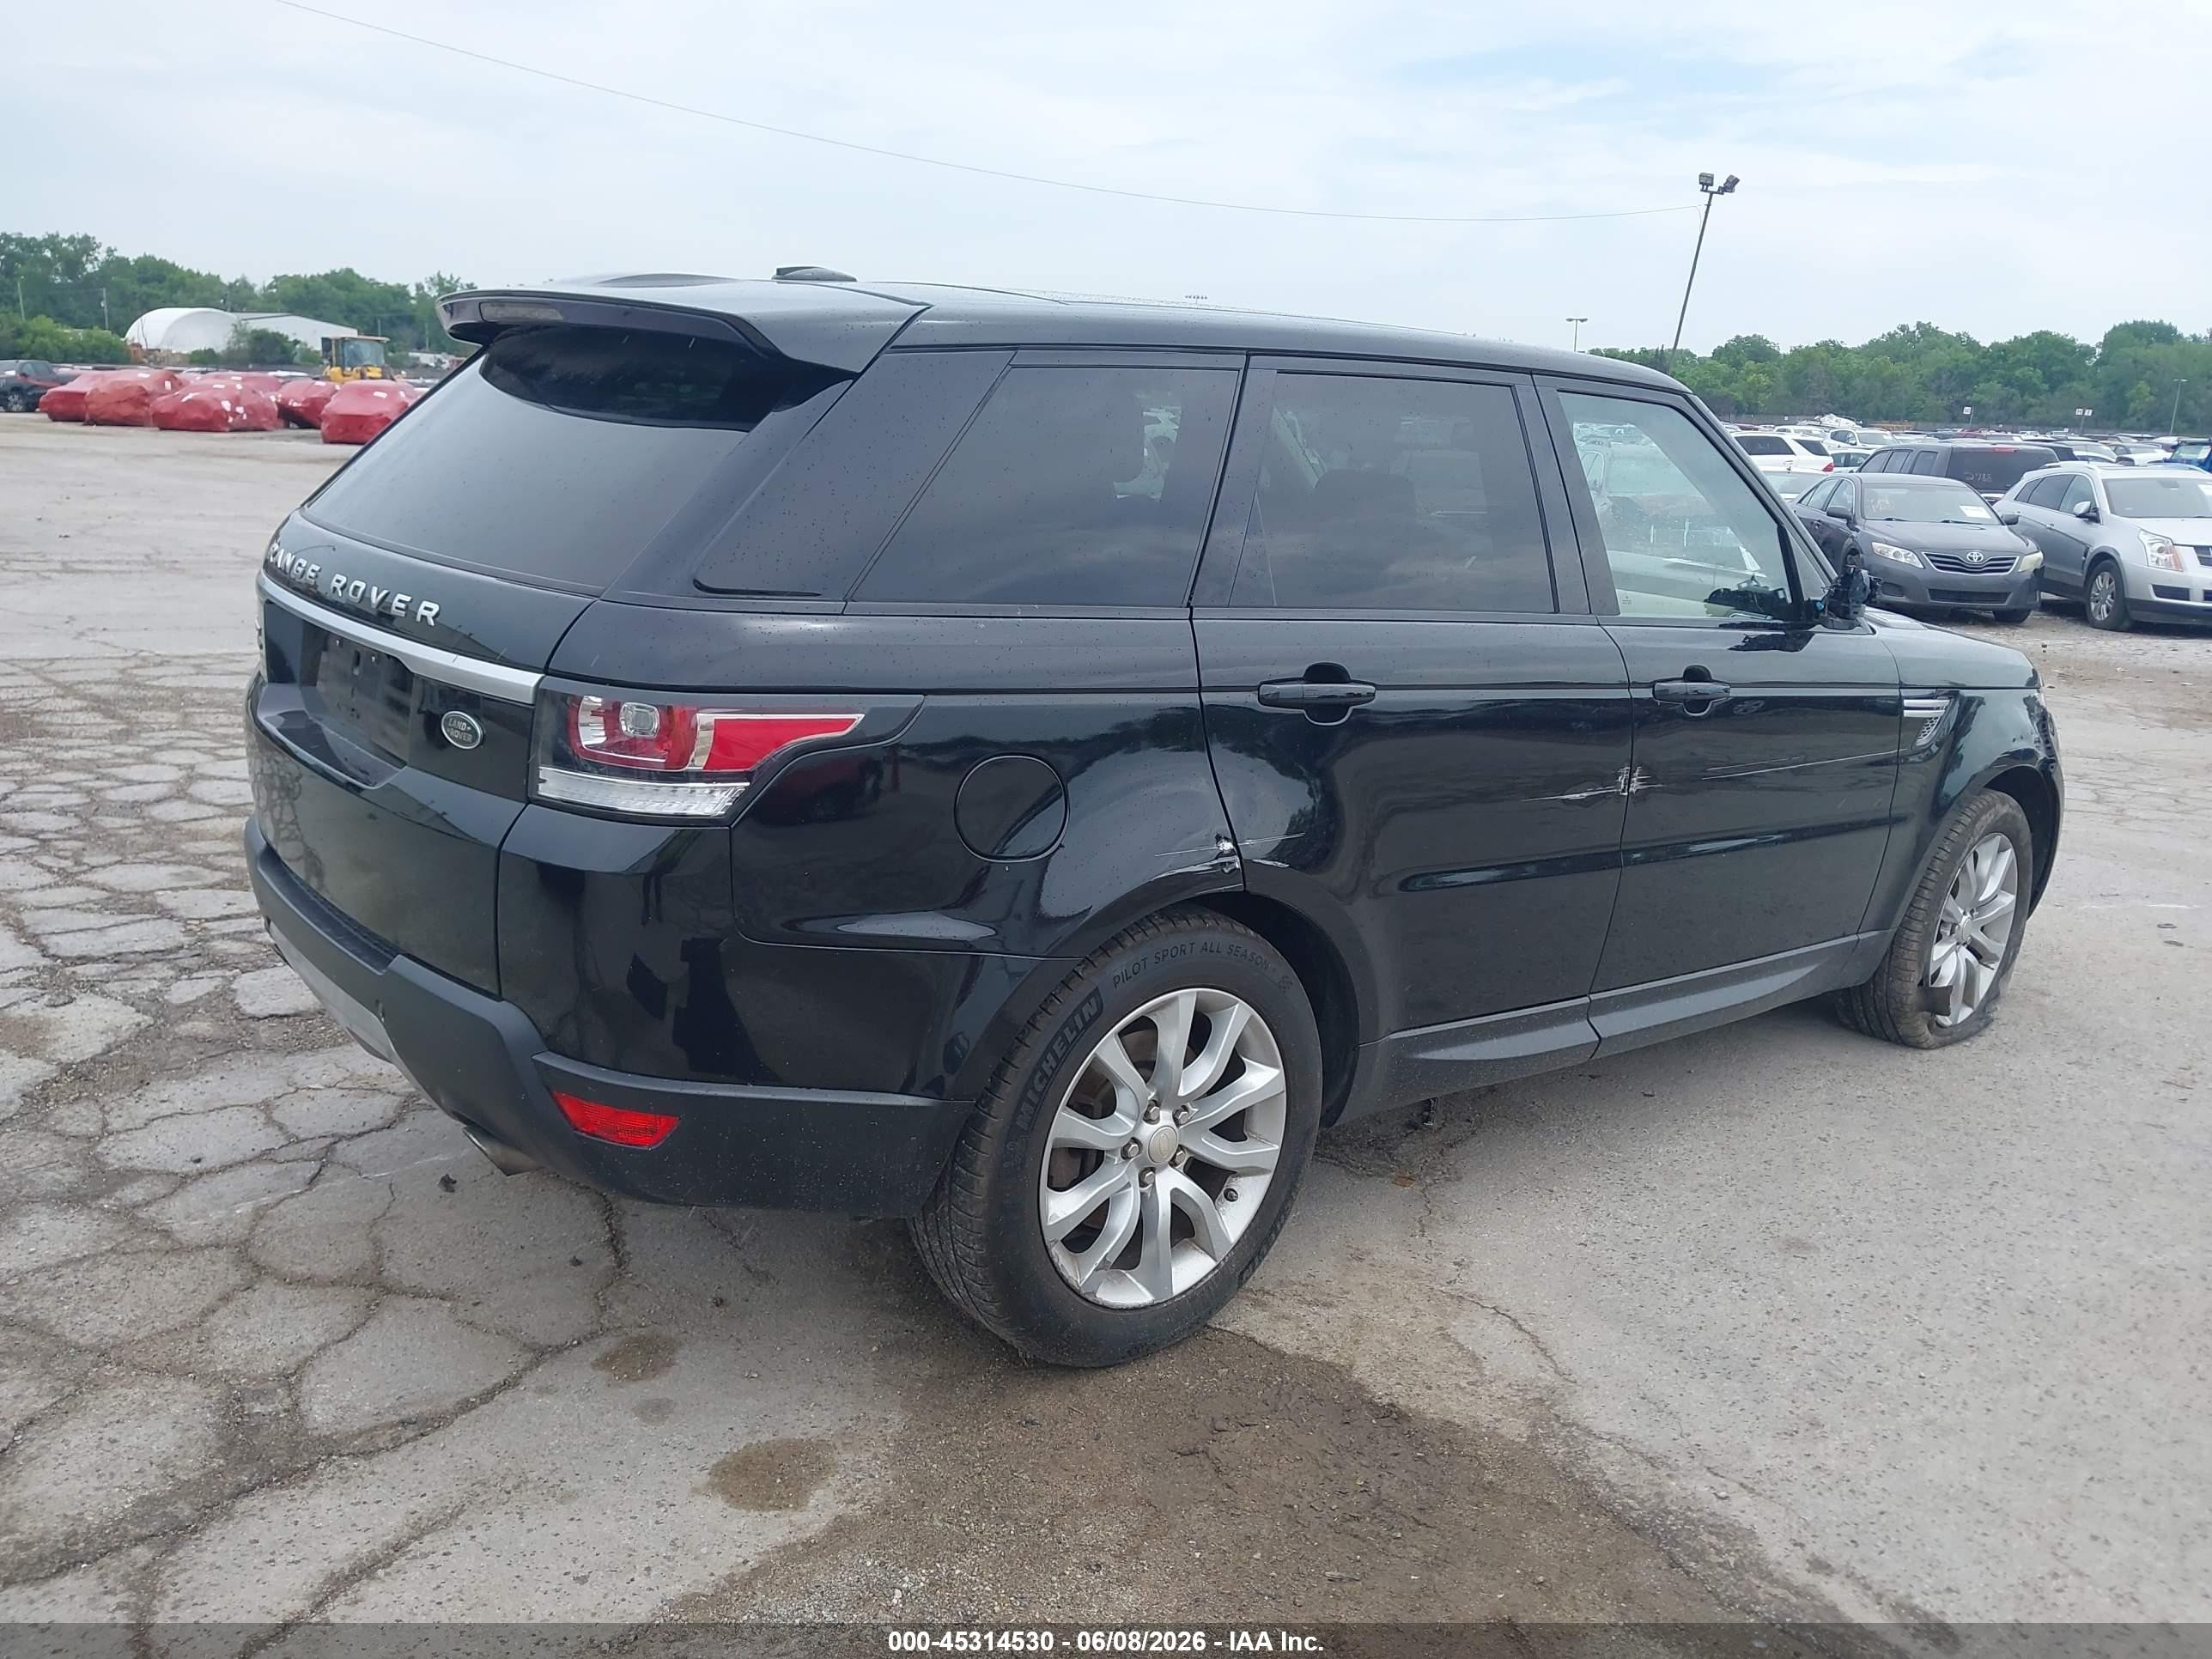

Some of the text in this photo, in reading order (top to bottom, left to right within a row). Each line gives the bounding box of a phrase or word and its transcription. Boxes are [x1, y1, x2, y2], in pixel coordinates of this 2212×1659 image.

[269, 542, 441, 627] RANGE ROVER
[1112, 941, 1271, 988] PILOT SPORT ALL SEASON
[1015, 998, 1099, 1130] MICHELIN
